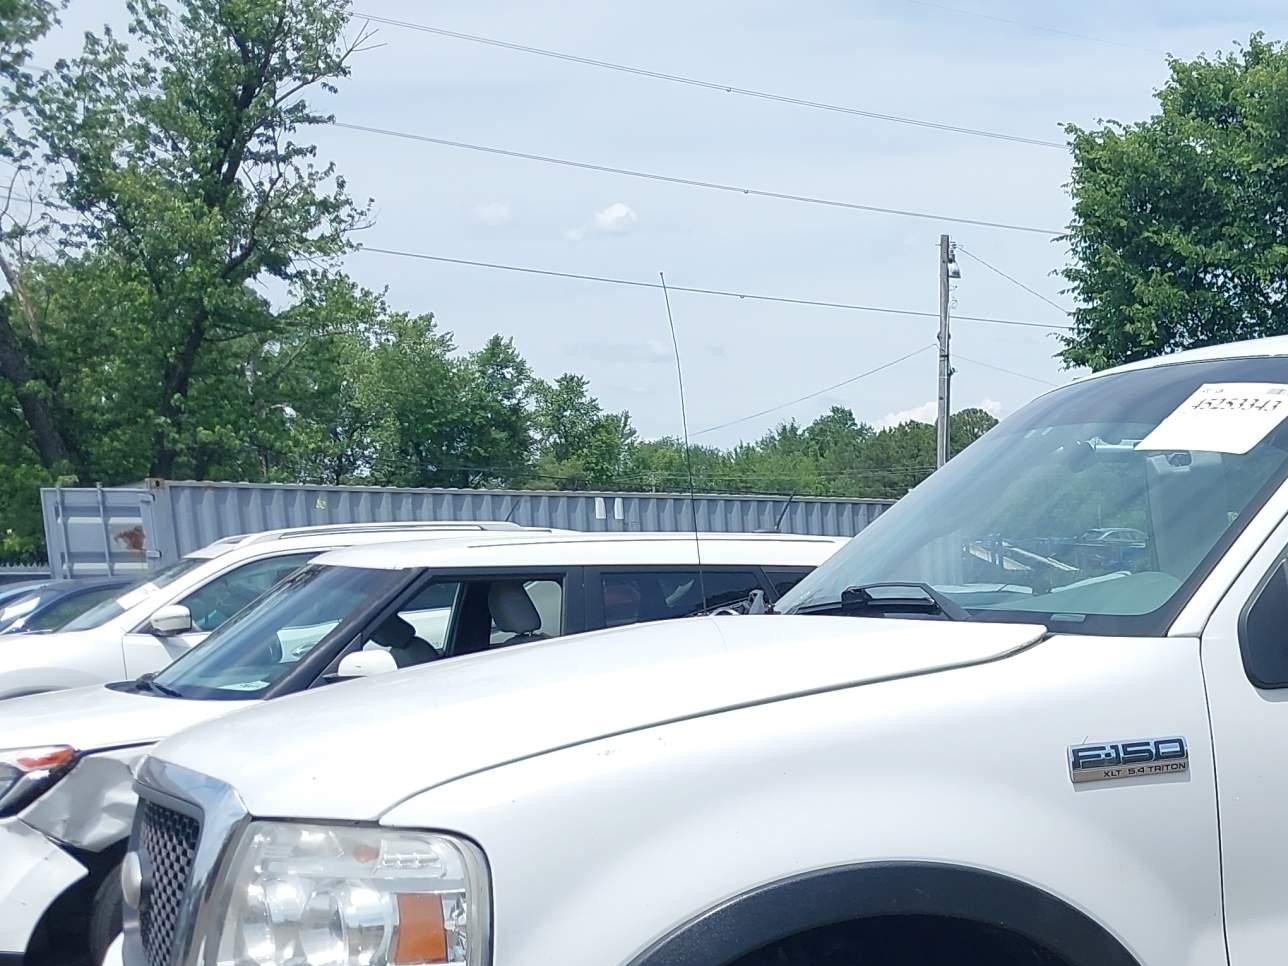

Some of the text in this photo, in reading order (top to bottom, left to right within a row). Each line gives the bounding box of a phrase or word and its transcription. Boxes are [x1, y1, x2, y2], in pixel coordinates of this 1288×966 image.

[1191, 397, 1282, 412] 45253343
[1103, 762, 1186, 778] XLT 5.4 TRITON
